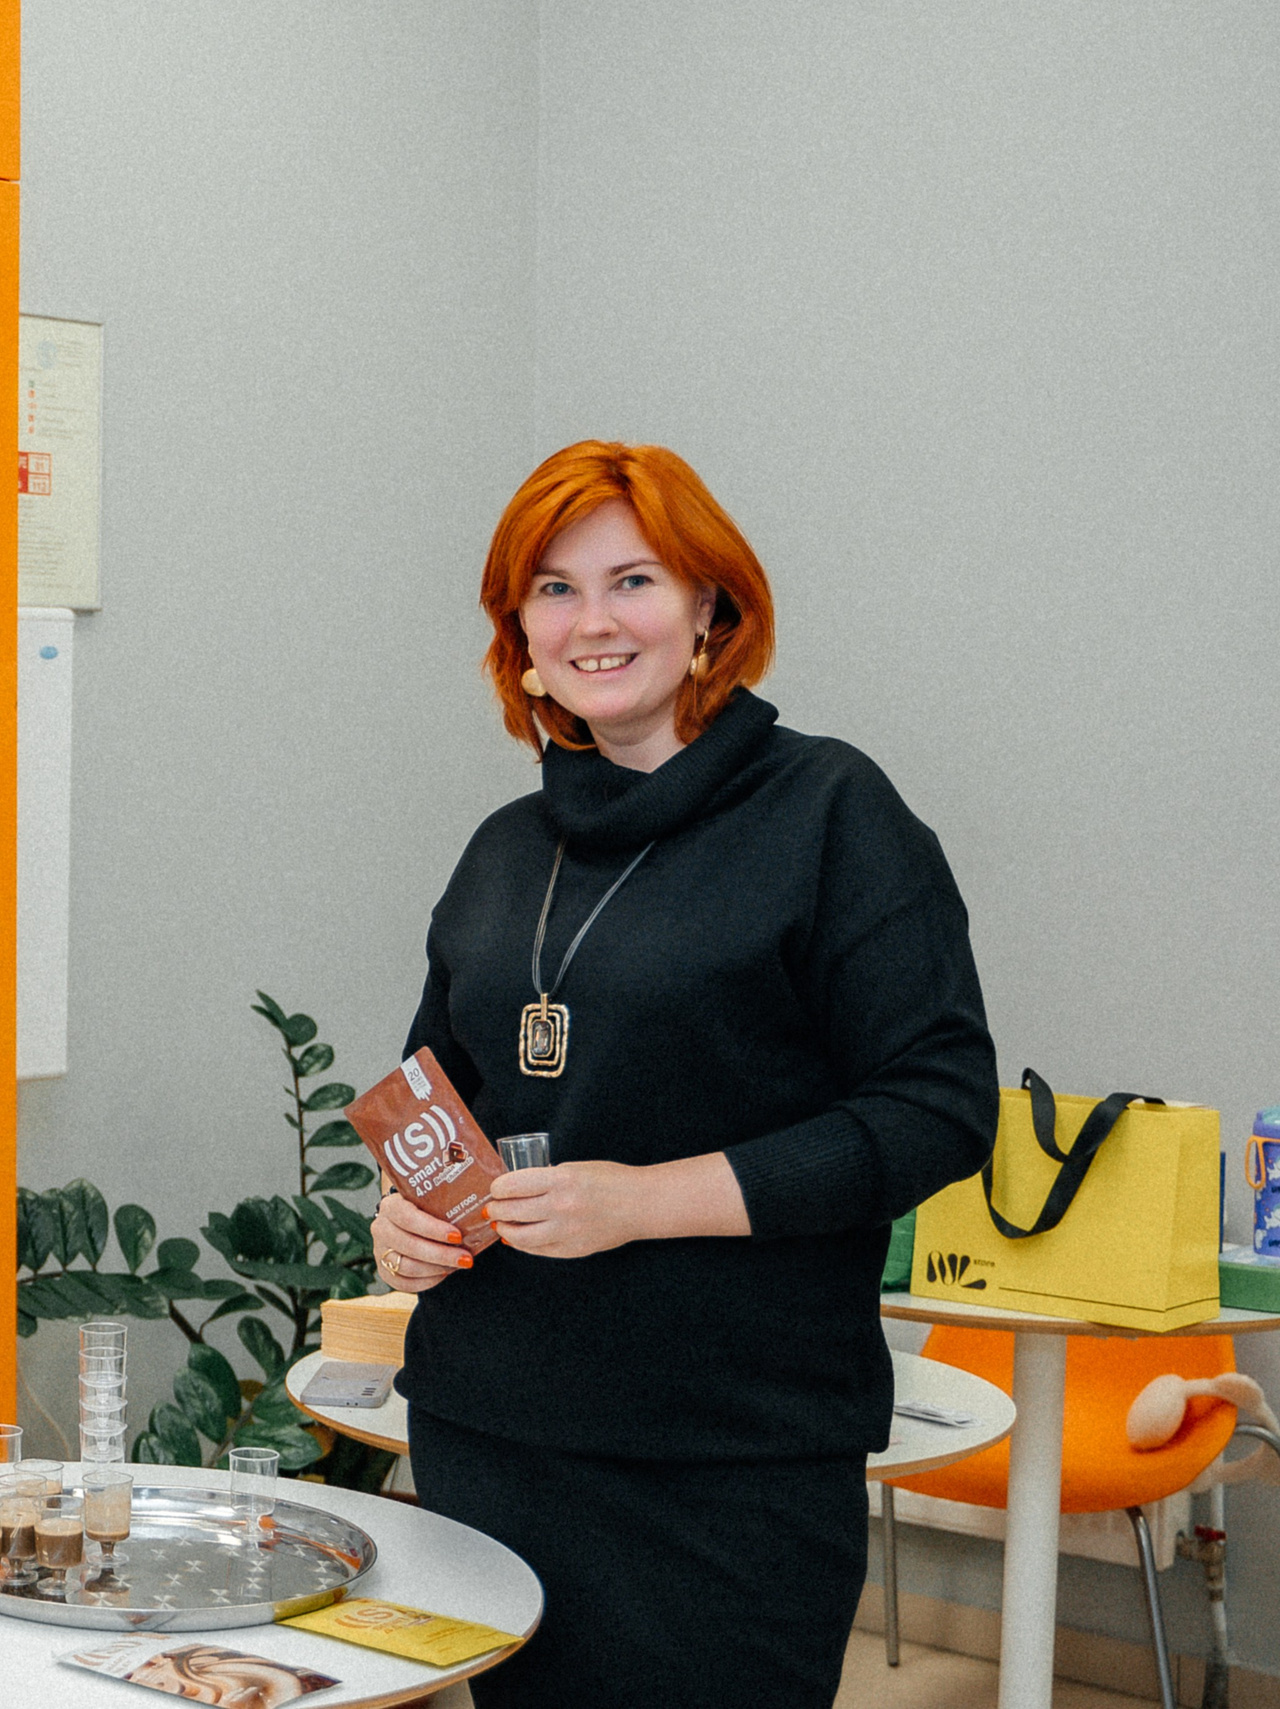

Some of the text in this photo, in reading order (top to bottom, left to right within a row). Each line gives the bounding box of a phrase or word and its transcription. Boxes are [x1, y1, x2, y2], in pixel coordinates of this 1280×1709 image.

[408, 1068, 420, 1081] 20
[408, 1156, 443, 1188] smart
[415, 1181, 433, 1197] 4.0
[446, 1205, 461, 1219] EASY
[460, 1193, 477, 1208] FOOD
